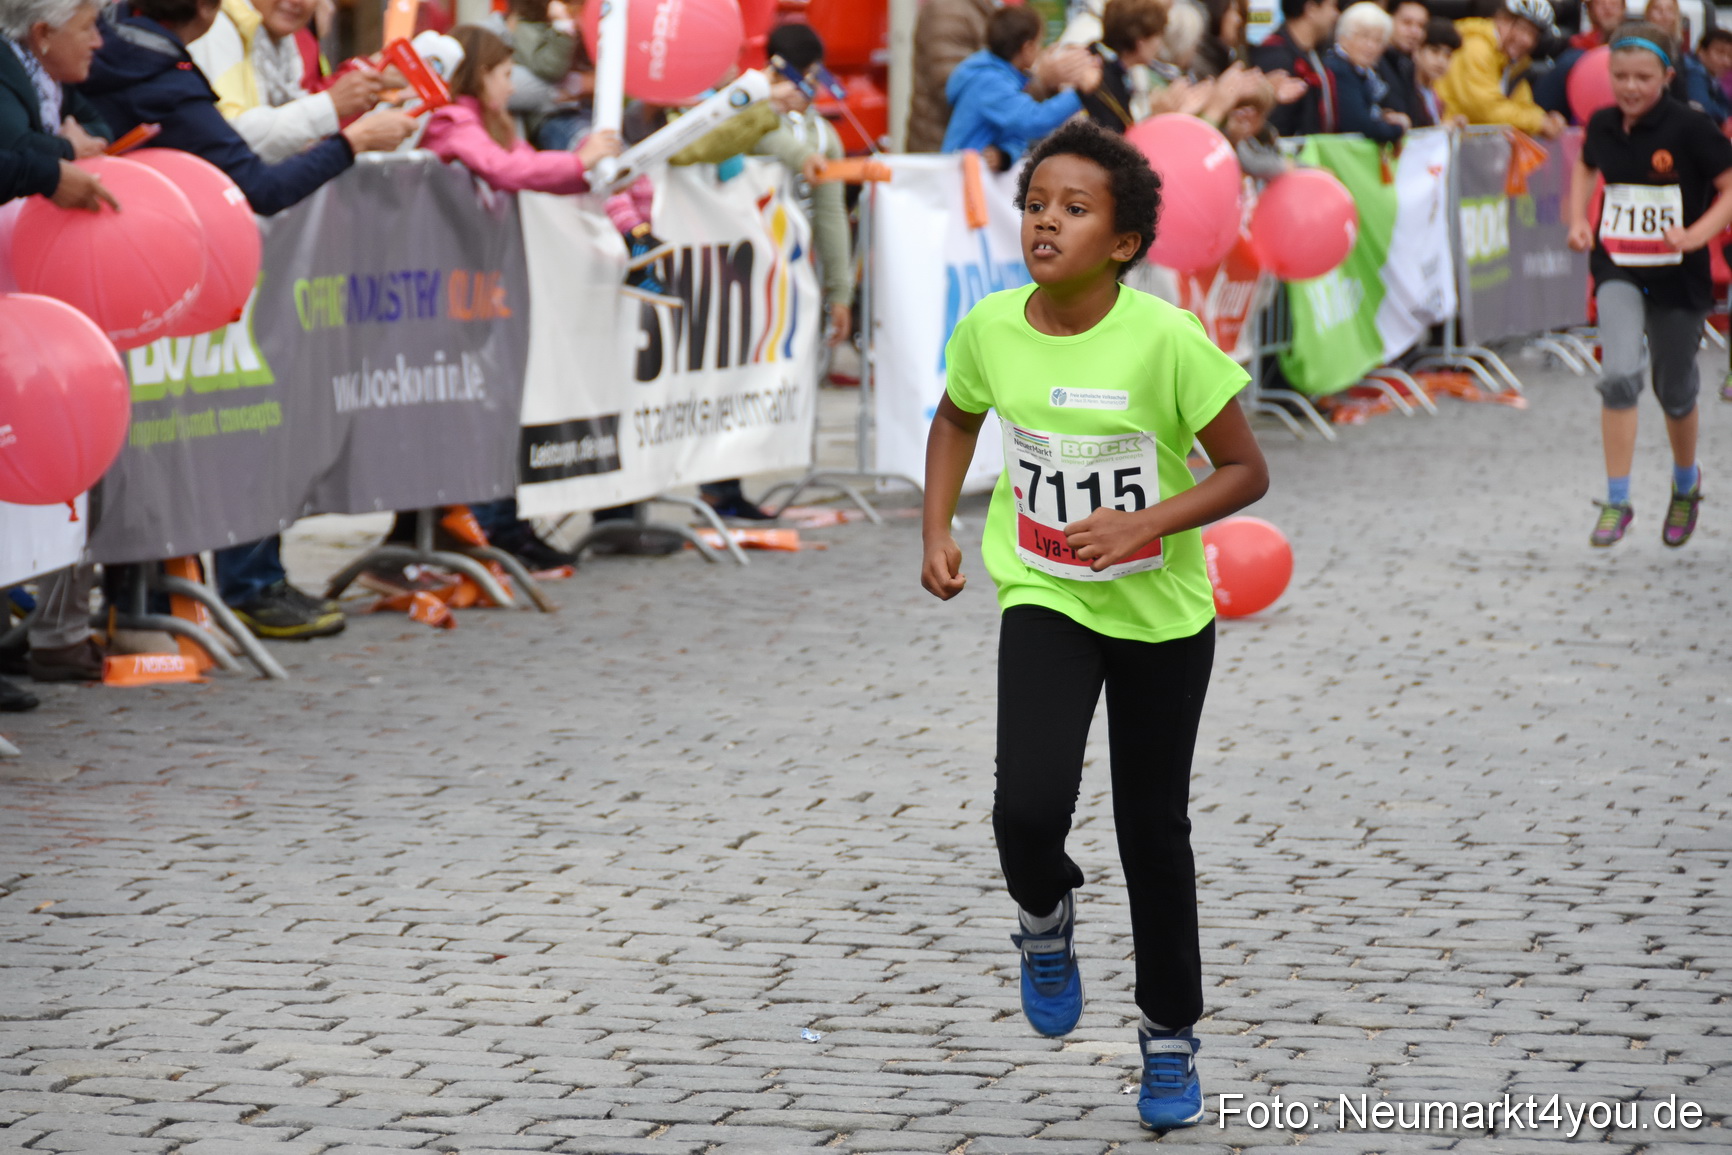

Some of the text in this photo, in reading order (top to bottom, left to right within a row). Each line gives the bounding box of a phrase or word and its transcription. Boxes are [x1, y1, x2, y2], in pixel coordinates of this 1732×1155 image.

[1611, 203, 1675, 234] 7185
[1060, 437, 1142, 459] BOCK
[1061, 458, 1085, 466] inspired
[1115, 453, 1144, 463] concepts
[1018, 459, 1146, 524] 7115
